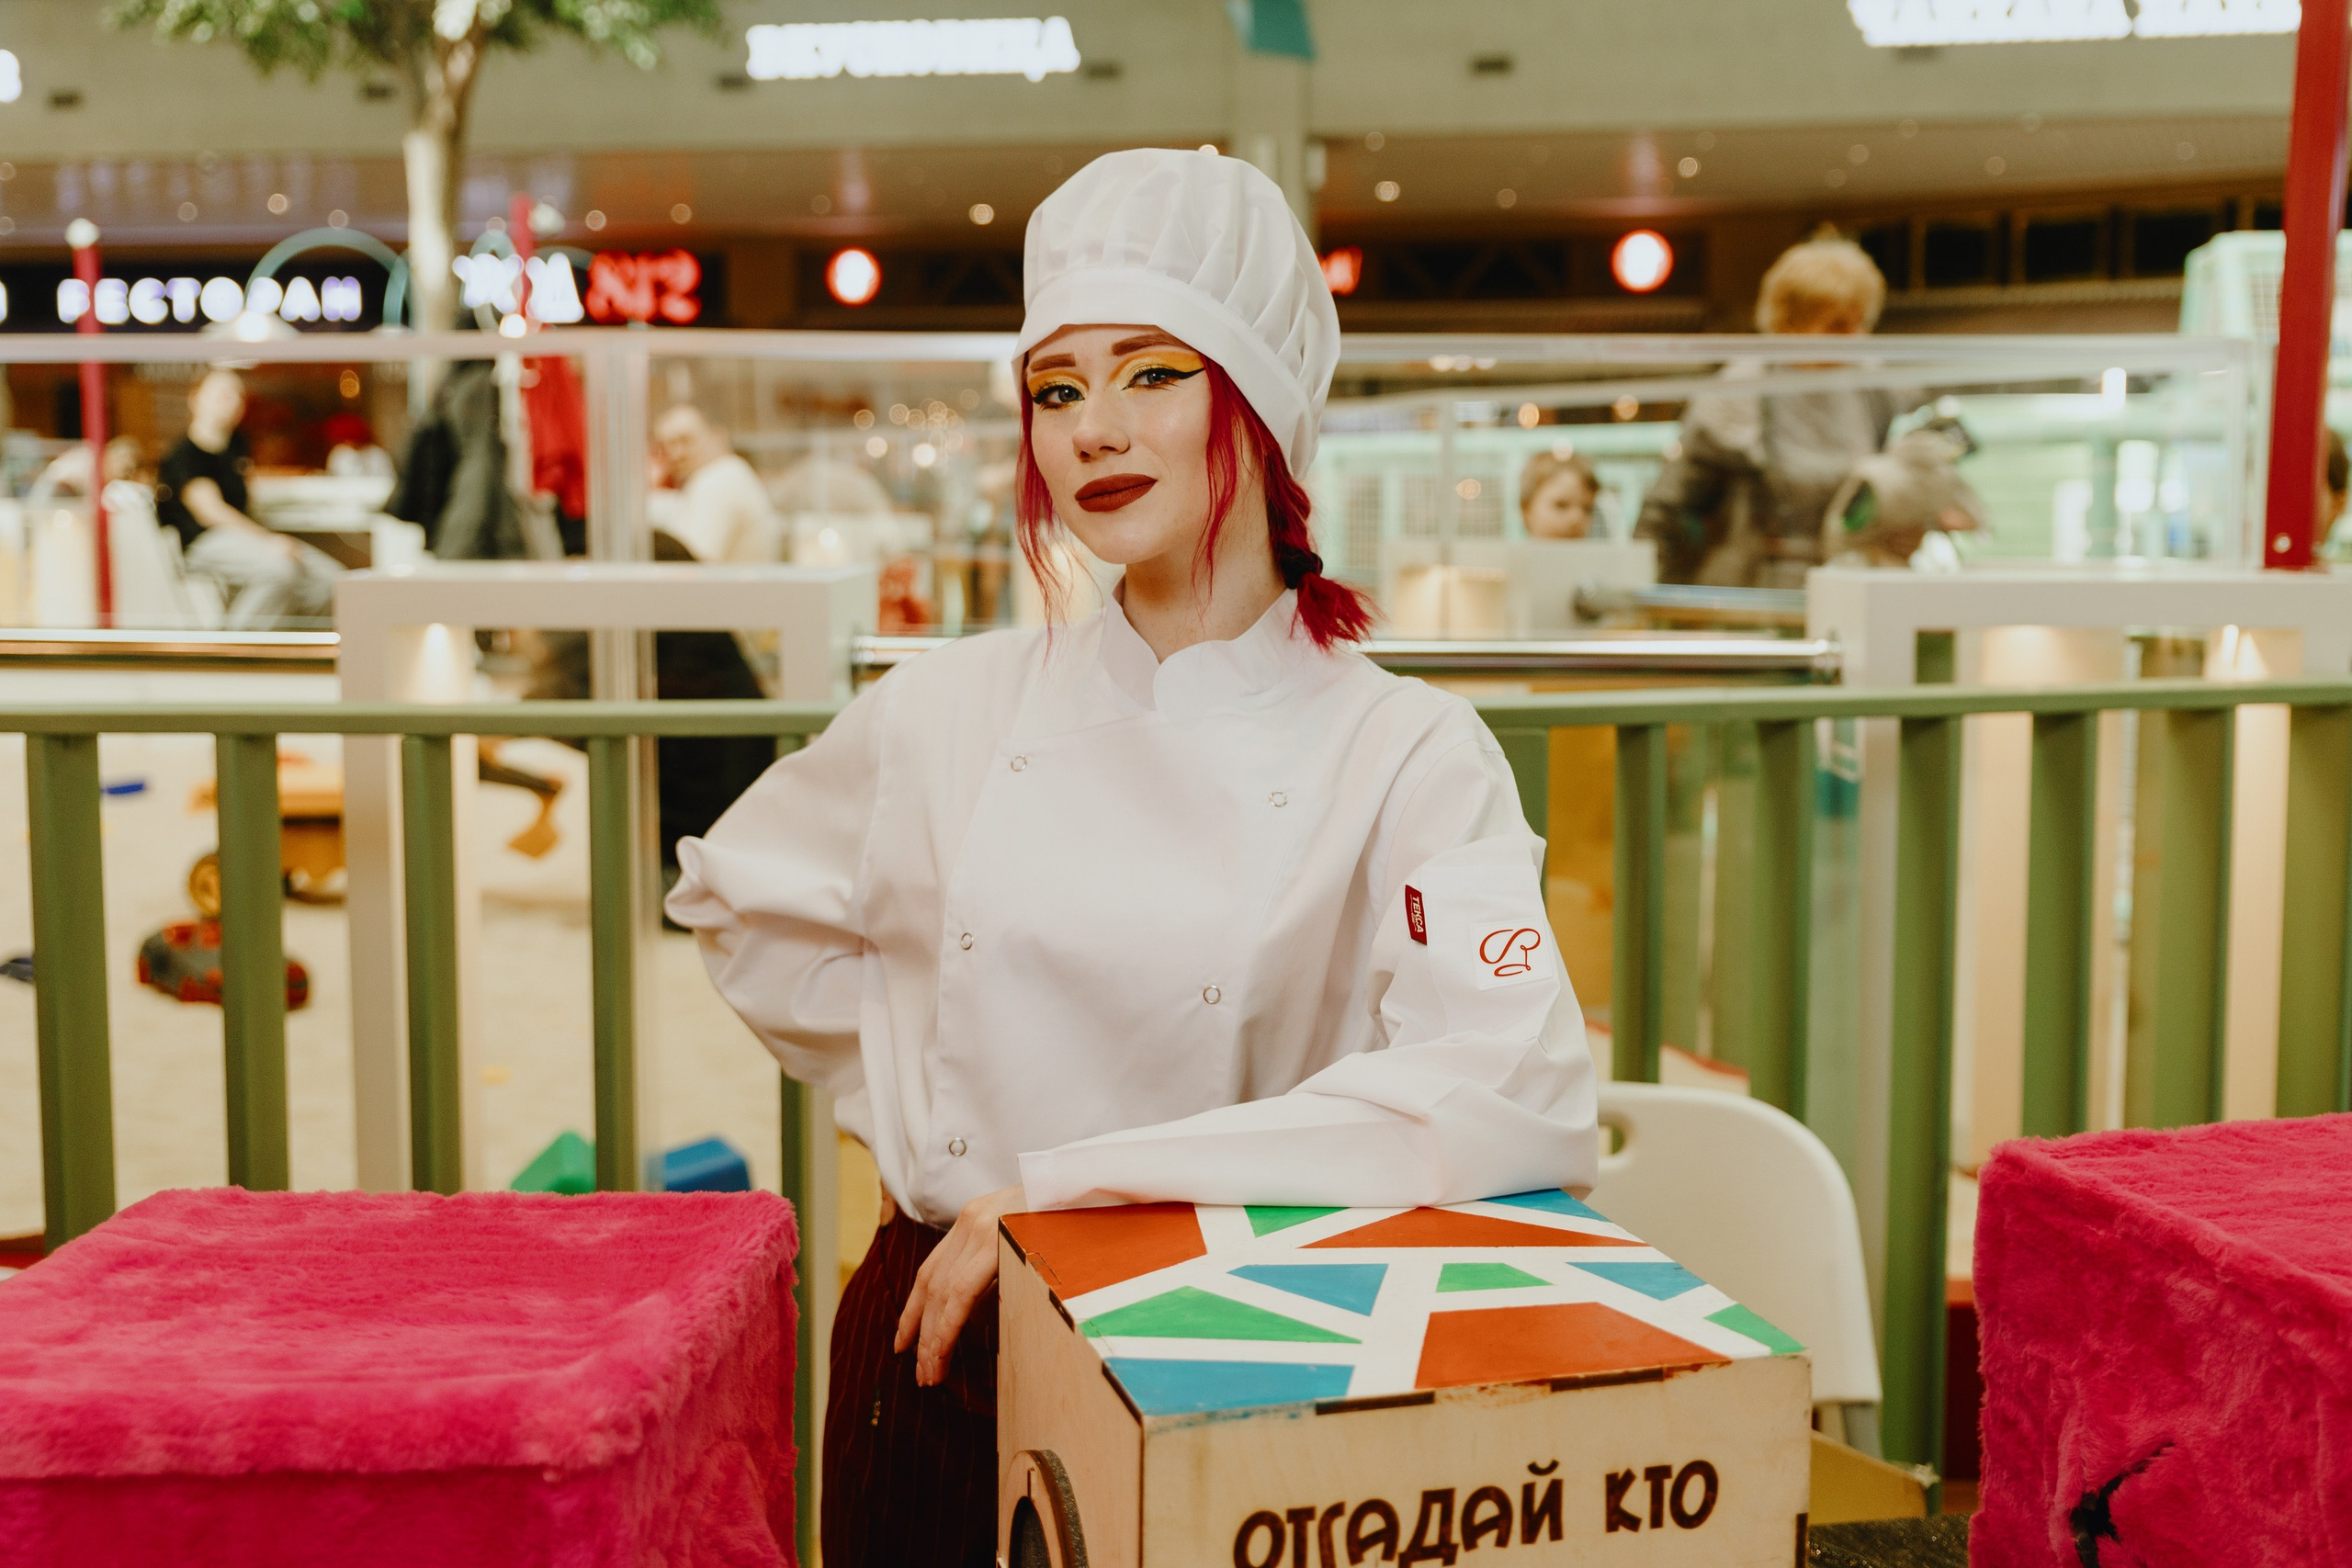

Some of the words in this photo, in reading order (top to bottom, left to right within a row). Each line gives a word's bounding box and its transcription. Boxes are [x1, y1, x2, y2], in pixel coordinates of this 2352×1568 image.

[57, 276, 362, 324] РЕСТОРАН
[1233, 1459, 1565, 1568] ОТГАДАЙ
[1605, 1460, 1718, 1533] КТО
